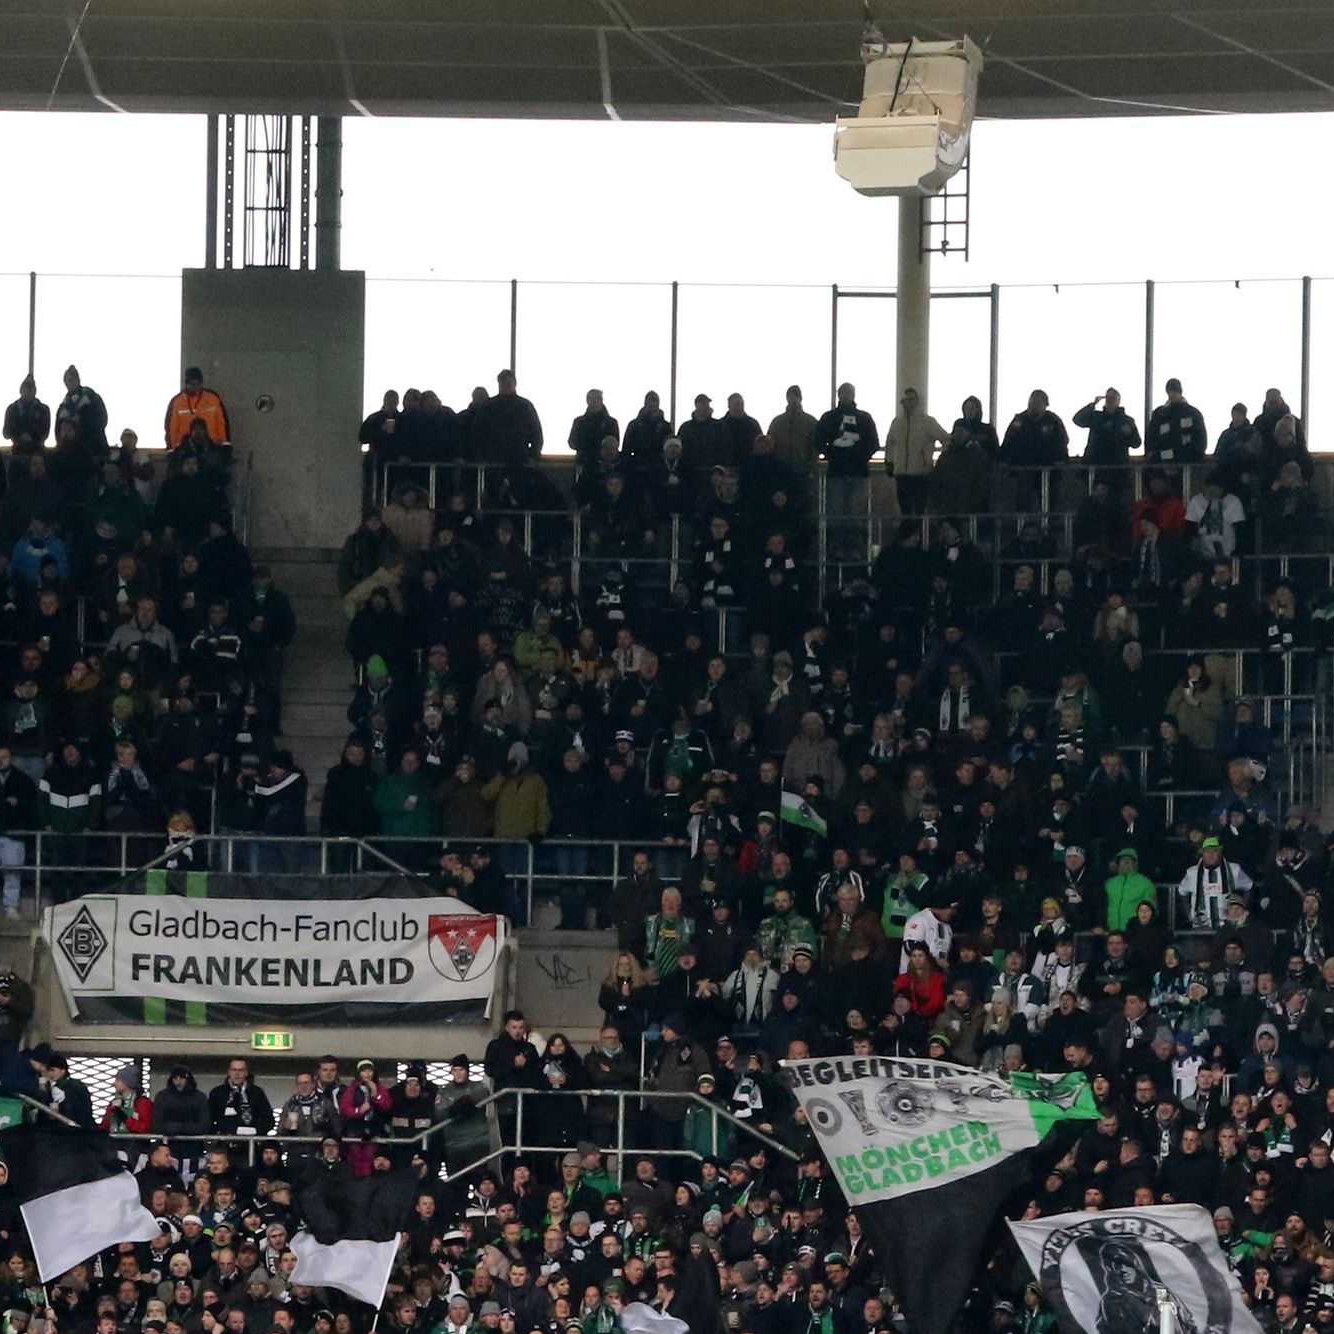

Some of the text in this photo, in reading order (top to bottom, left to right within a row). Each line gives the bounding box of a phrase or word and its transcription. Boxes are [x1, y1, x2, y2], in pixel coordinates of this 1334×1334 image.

[128, 909, 419, 943] Gladbach-Fanclub
[131, 952, 414, 987] FRANKENLAND
[833, 1120, 991, 1177] MÖNCHEN
[843, 1132, 1004, 1195] GLADBACH
